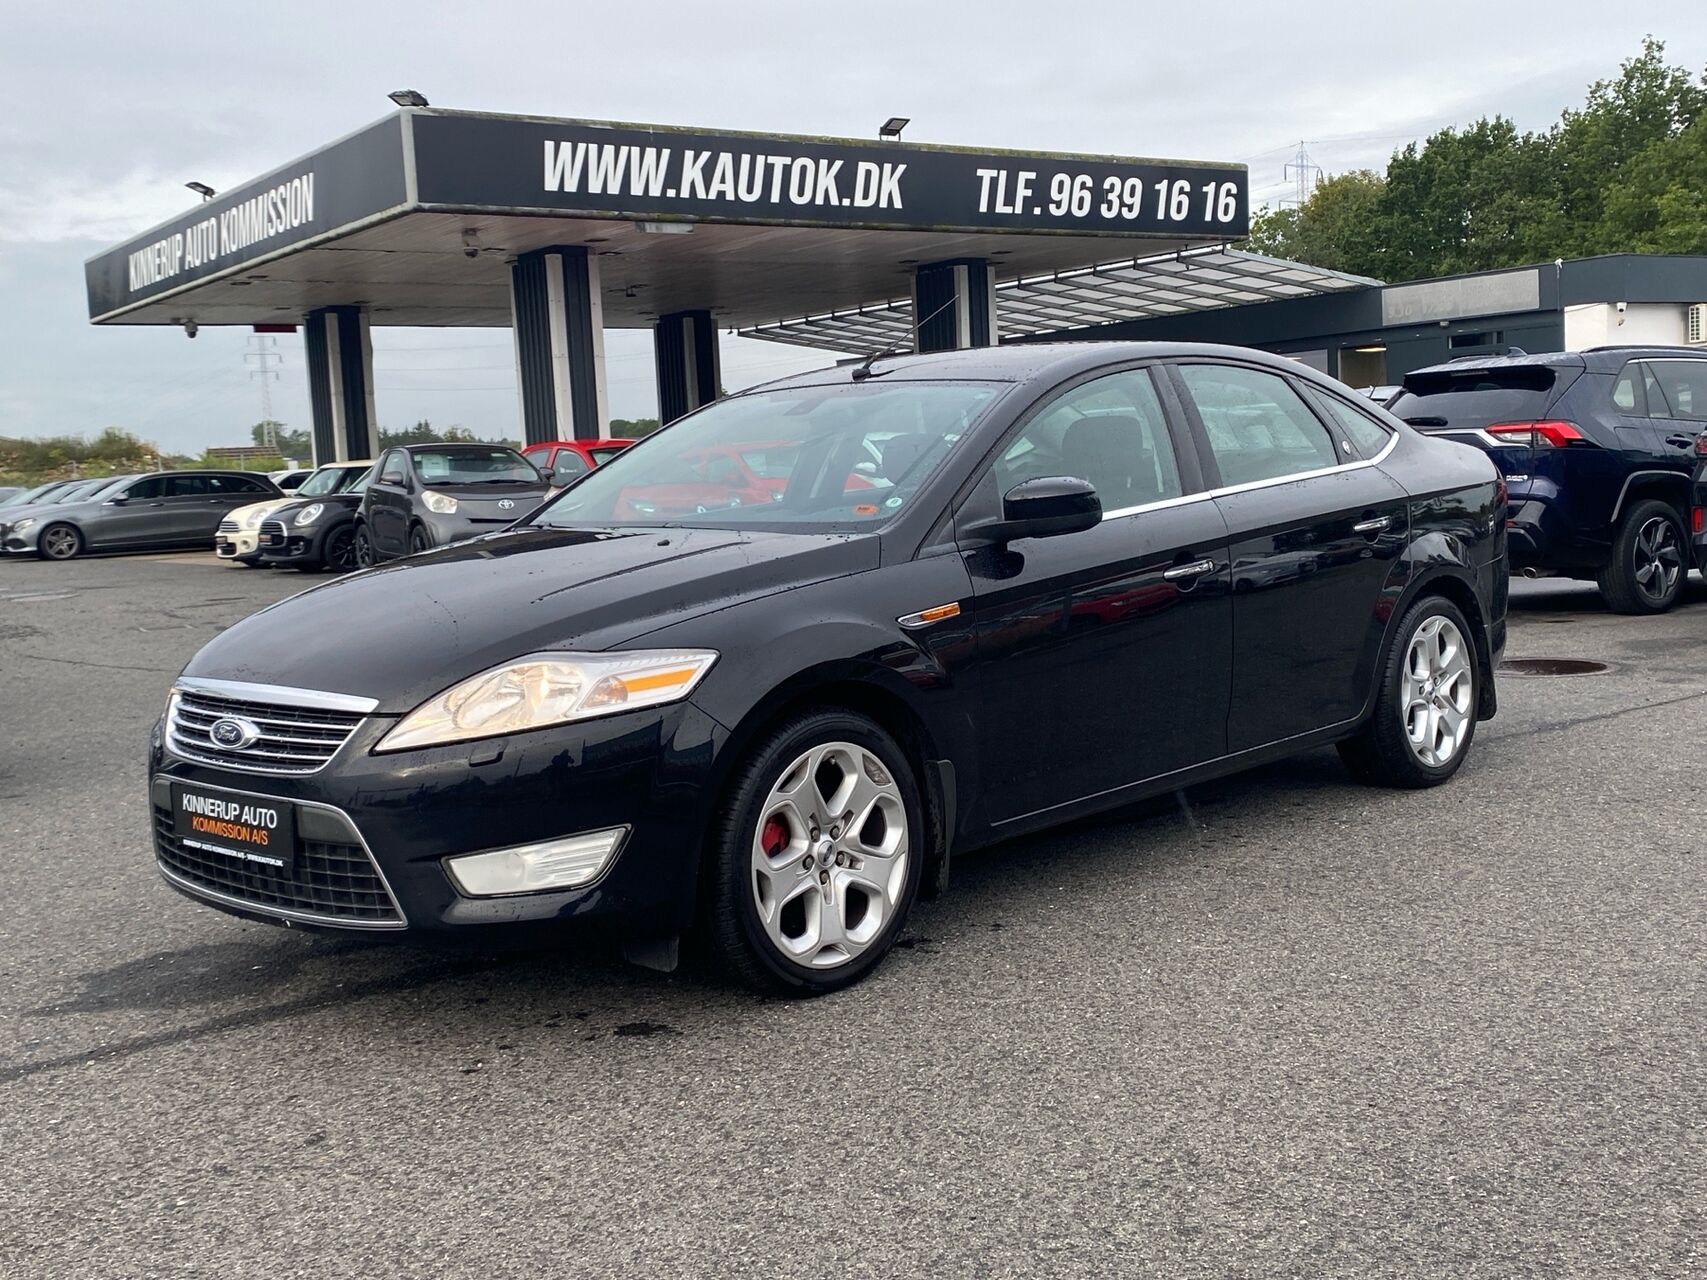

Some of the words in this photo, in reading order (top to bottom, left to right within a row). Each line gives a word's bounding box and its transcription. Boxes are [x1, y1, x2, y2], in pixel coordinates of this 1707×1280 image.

[543, 140, 908, 209] WWW.KAUTOK.DK
[976, 168, 1041, 215] TLF.
[1049, 173, 1094, 218] 96
[1100, 176, 1143, 220] 39
[1154, 179, 1191, 222] 16
[1202, 181, 1238, 223] 16
[128, 233, 183, 293] KINNERUP
[184, 216, 218, 271] AUTO
[220, 172, 315, 257] KOMMISSION
[182, 793, 240, 821] KINNERUP
[241, 805, 278, 829] AUTO
[192, 816, 250, 842] KOMMISSION
[251, 829, 269, 846] A/S
